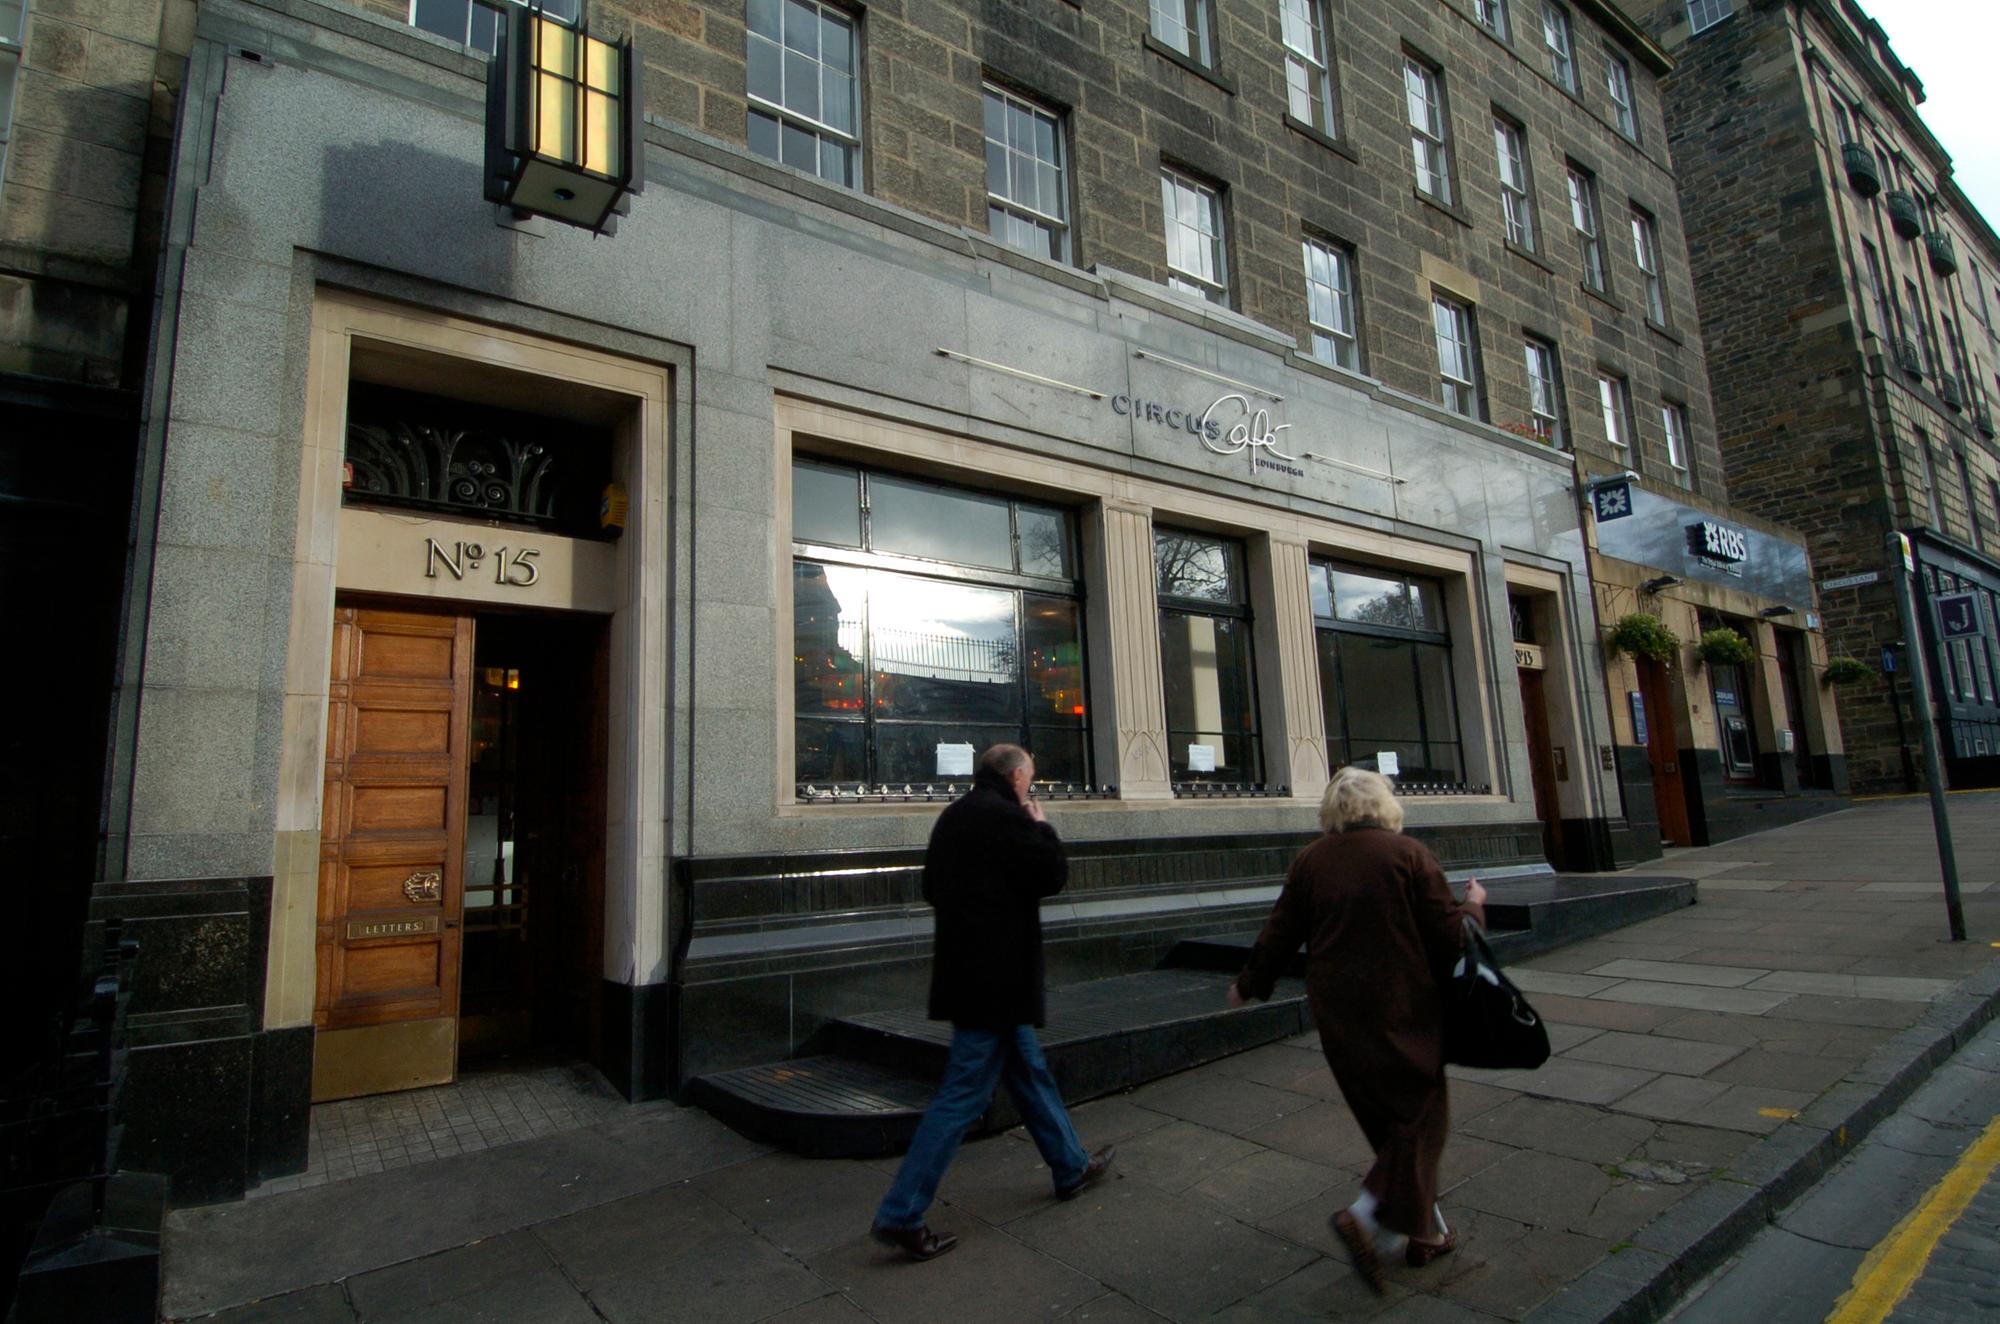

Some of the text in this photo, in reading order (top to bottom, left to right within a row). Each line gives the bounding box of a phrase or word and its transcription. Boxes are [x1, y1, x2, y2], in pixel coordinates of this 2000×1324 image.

[1112, 393, 1296, 474] CIRCUS Café
[1255, 458, 1304, 477] EDINBURGH
[1718, 526, 1747, 561] RBS
[494, 546, 540, 587] 15
[366, 922, 419, 934] LETTERS
